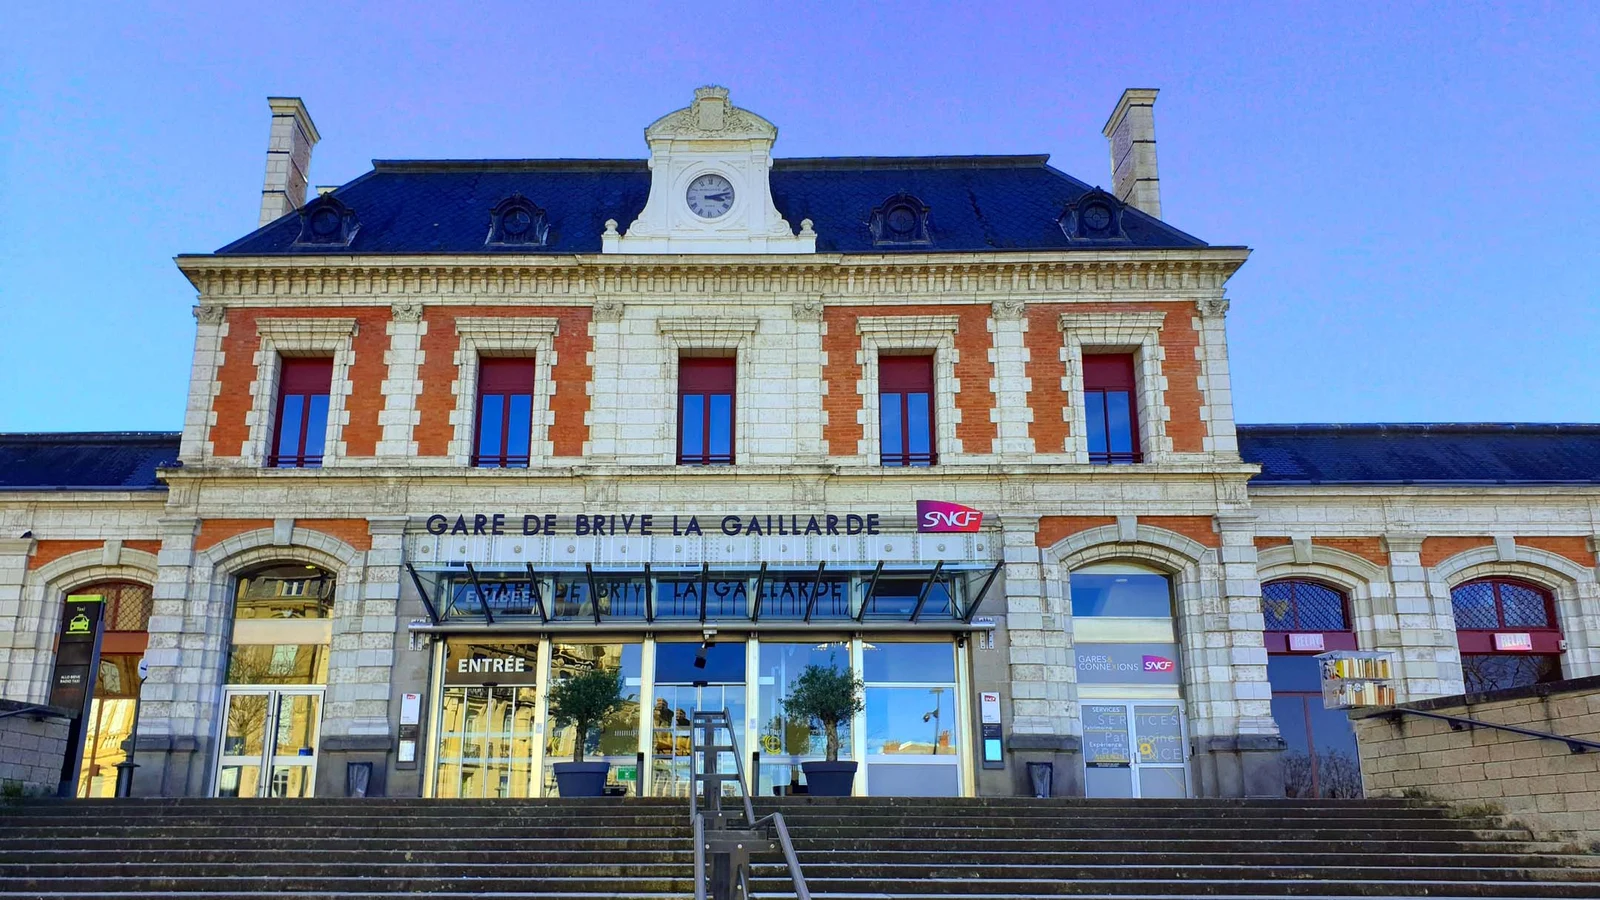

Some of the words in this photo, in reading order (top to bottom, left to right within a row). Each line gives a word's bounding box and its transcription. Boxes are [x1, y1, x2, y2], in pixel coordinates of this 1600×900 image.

[922, 510, 981, 527] SNCF
[426, 514, 505, 536] GARE
[523, 514, 556, 536] DE
[575, 514, 653, 536] BRIVE
[672, 514, 703, 536] LA
[720, 513, 880, 536] GAILLARDE
[458, 655, 525, 672] ENTRÉE
[1079, 655, 1106, 663] GARES
[1079, 663, 1138, 671] CONNEXIONS
[1144, 661, 1172, 670] SNCF
[1097, 715, 1178, 726] SERICES
